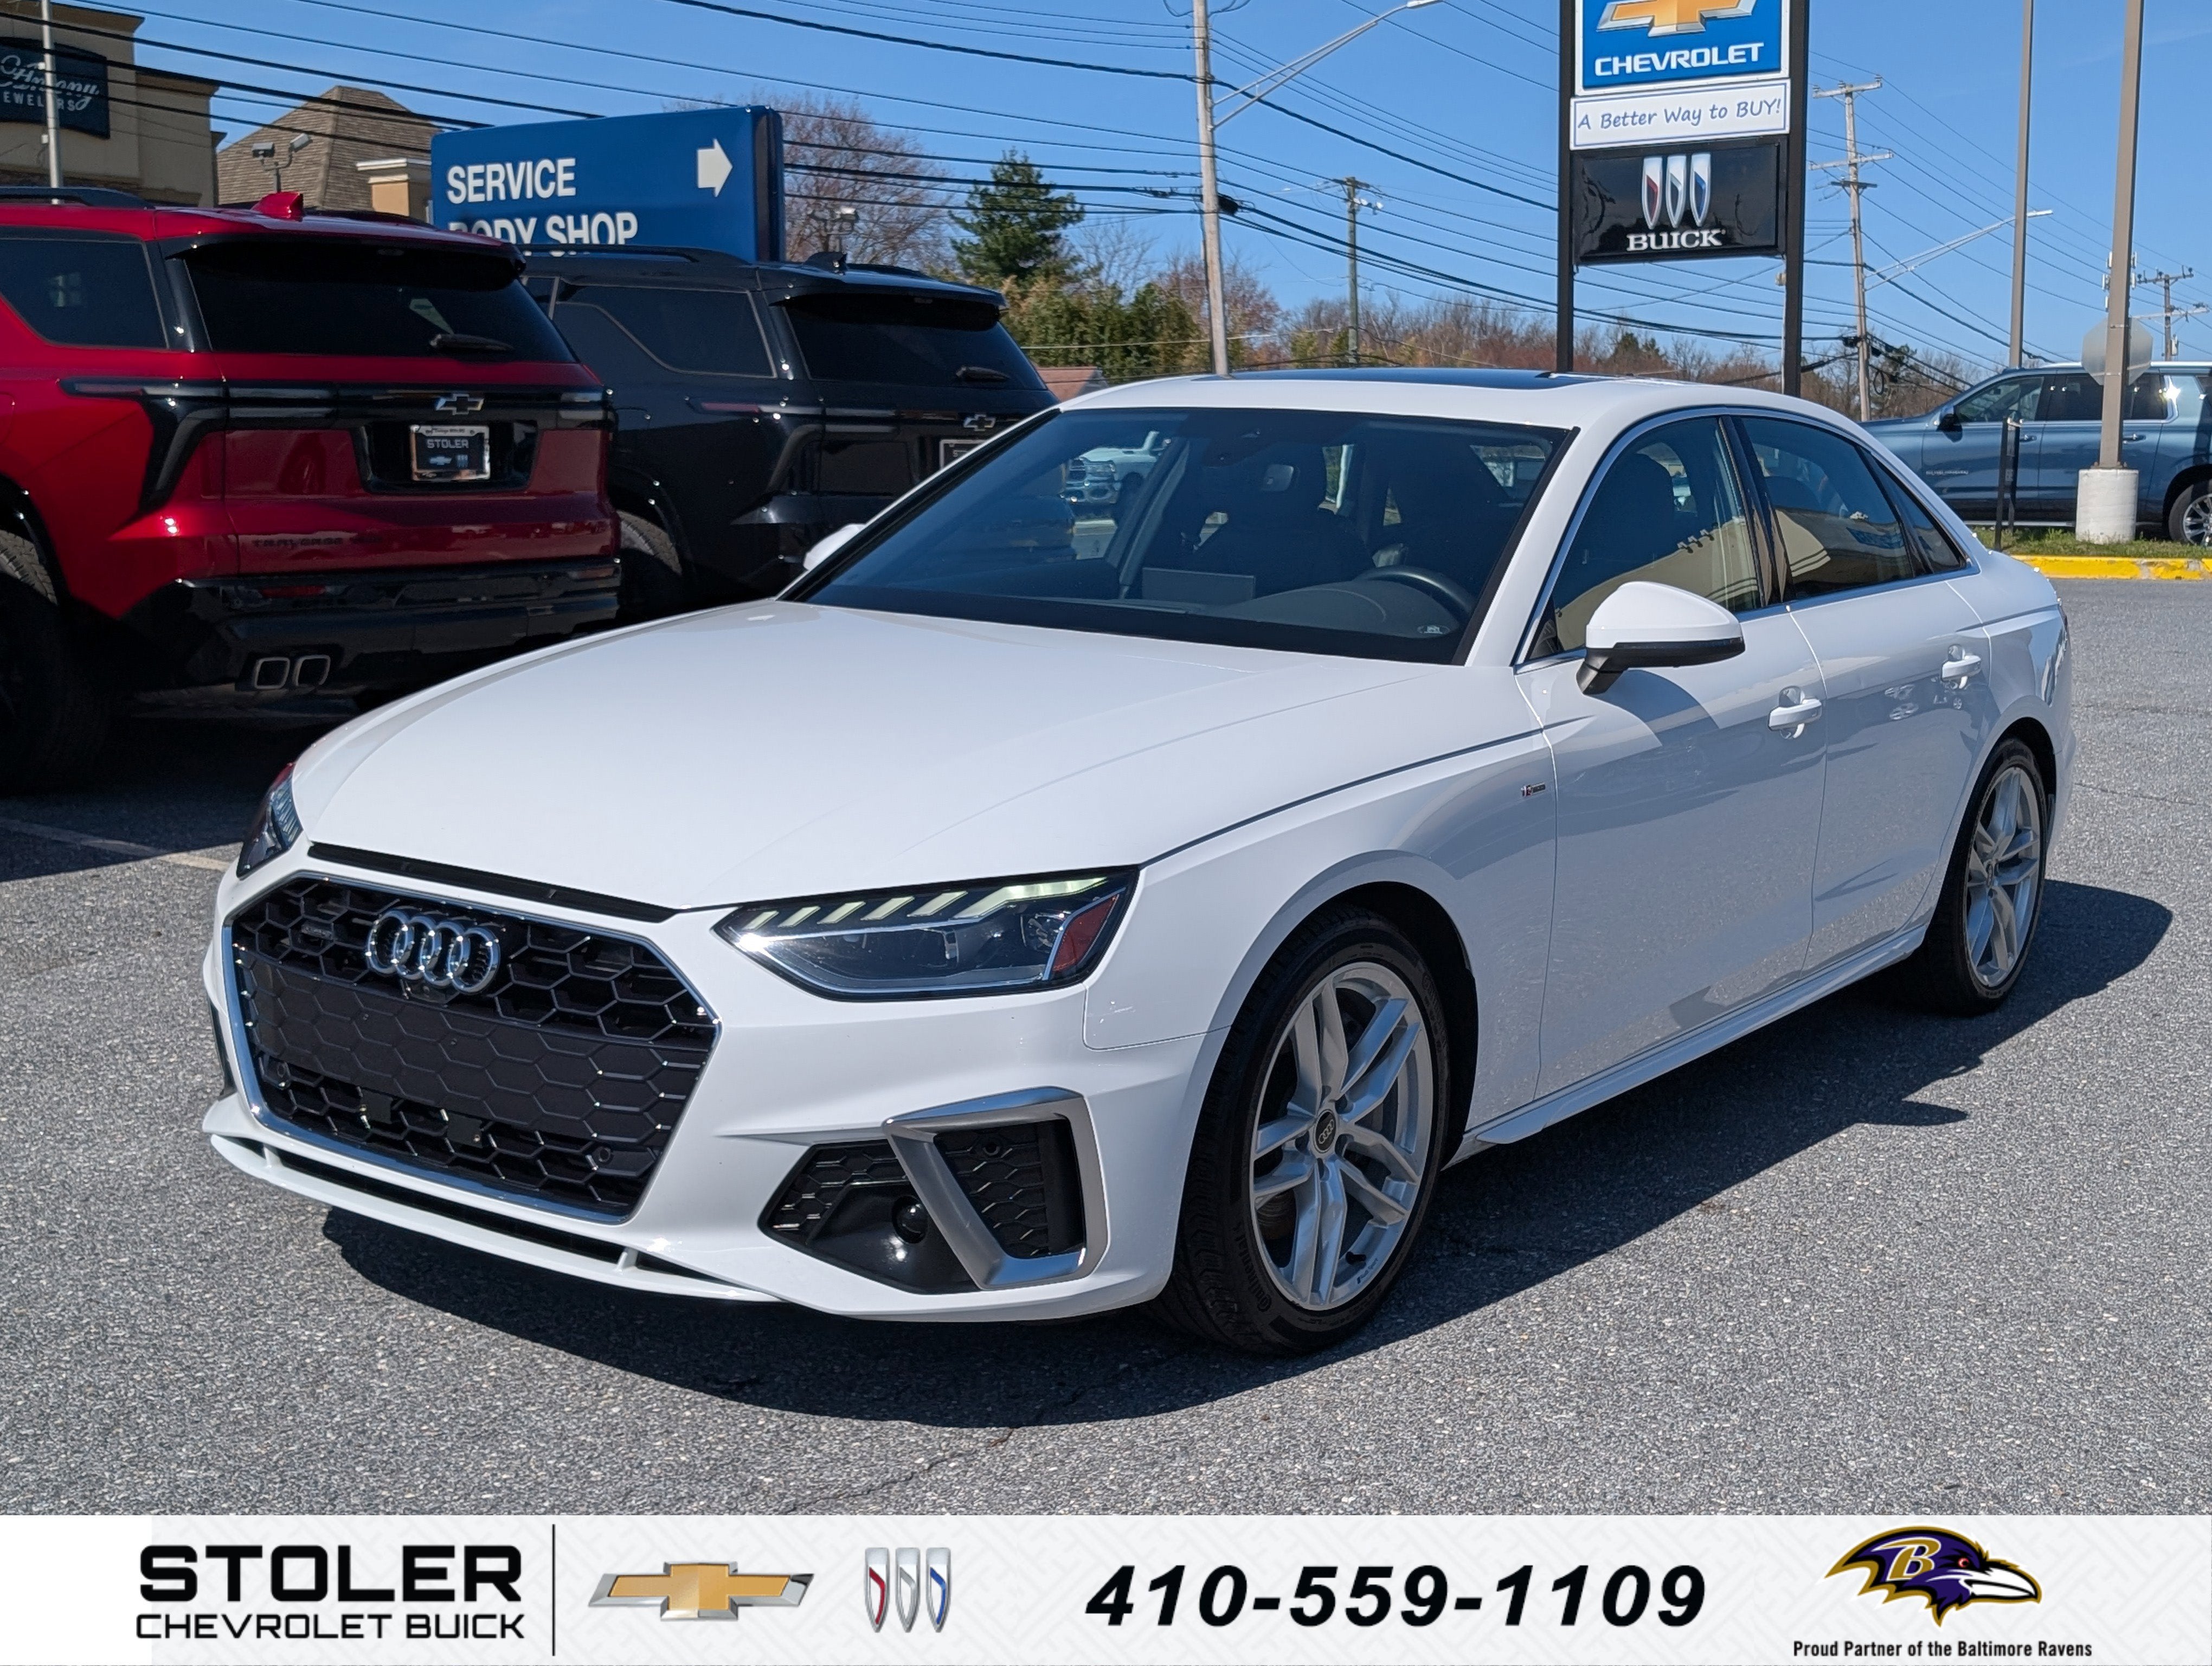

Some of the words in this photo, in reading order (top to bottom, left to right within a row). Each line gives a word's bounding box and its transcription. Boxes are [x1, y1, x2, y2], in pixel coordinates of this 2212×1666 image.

[1594, 42, 1764, 76] CHEVROLET
[1578, 114, 1591, 130] A
[1600, 111, 1657, 129] Better
[1664, 107, 1702, 126] Way
[1709, 104, 1728, 119] to
[1736, 98, 1782, 118] BUY!
[447, 157, 576, 204] SERVICE
[448, 217, 537, 257] DY
[545, 212, 638, 257] SHOP
[1626, 228, 1723, 251] BUICK
[426, 438, 470, 449] STOLER
